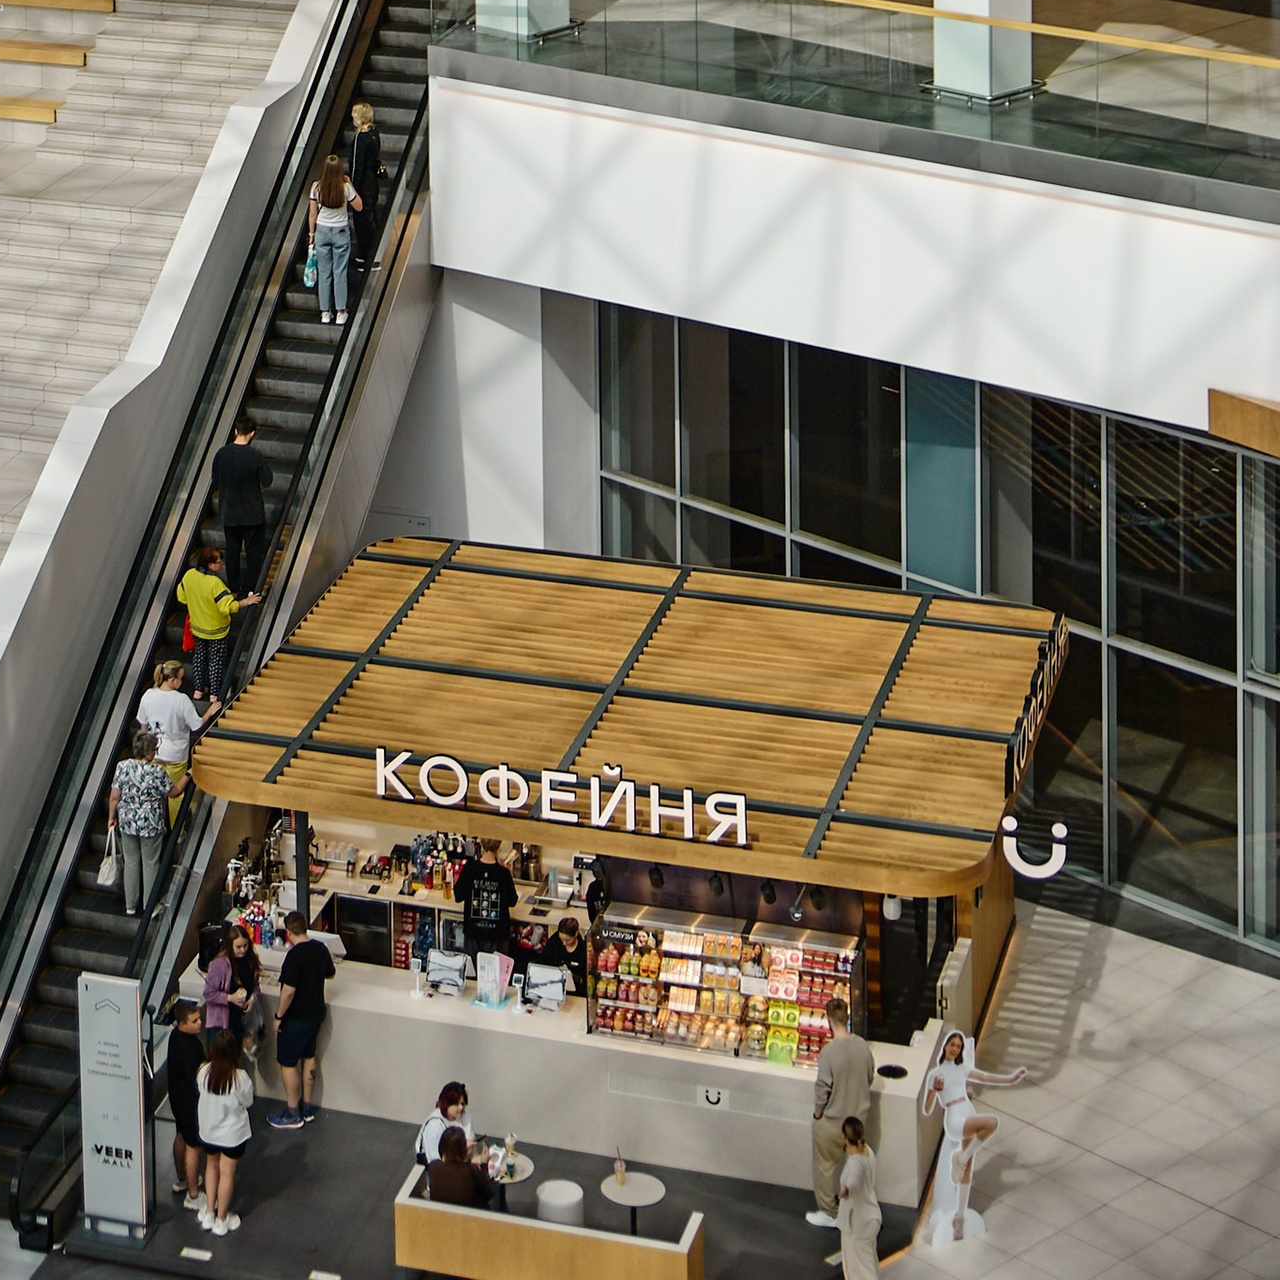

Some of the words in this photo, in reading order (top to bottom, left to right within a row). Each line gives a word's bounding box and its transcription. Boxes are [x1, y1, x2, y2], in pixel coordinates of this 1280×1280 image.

[375, 747, 748, 846] КОФЕЙНЯ
[93, 1143, 133, 1161] VEER
[102, 1157, 131, 1169] MALL
